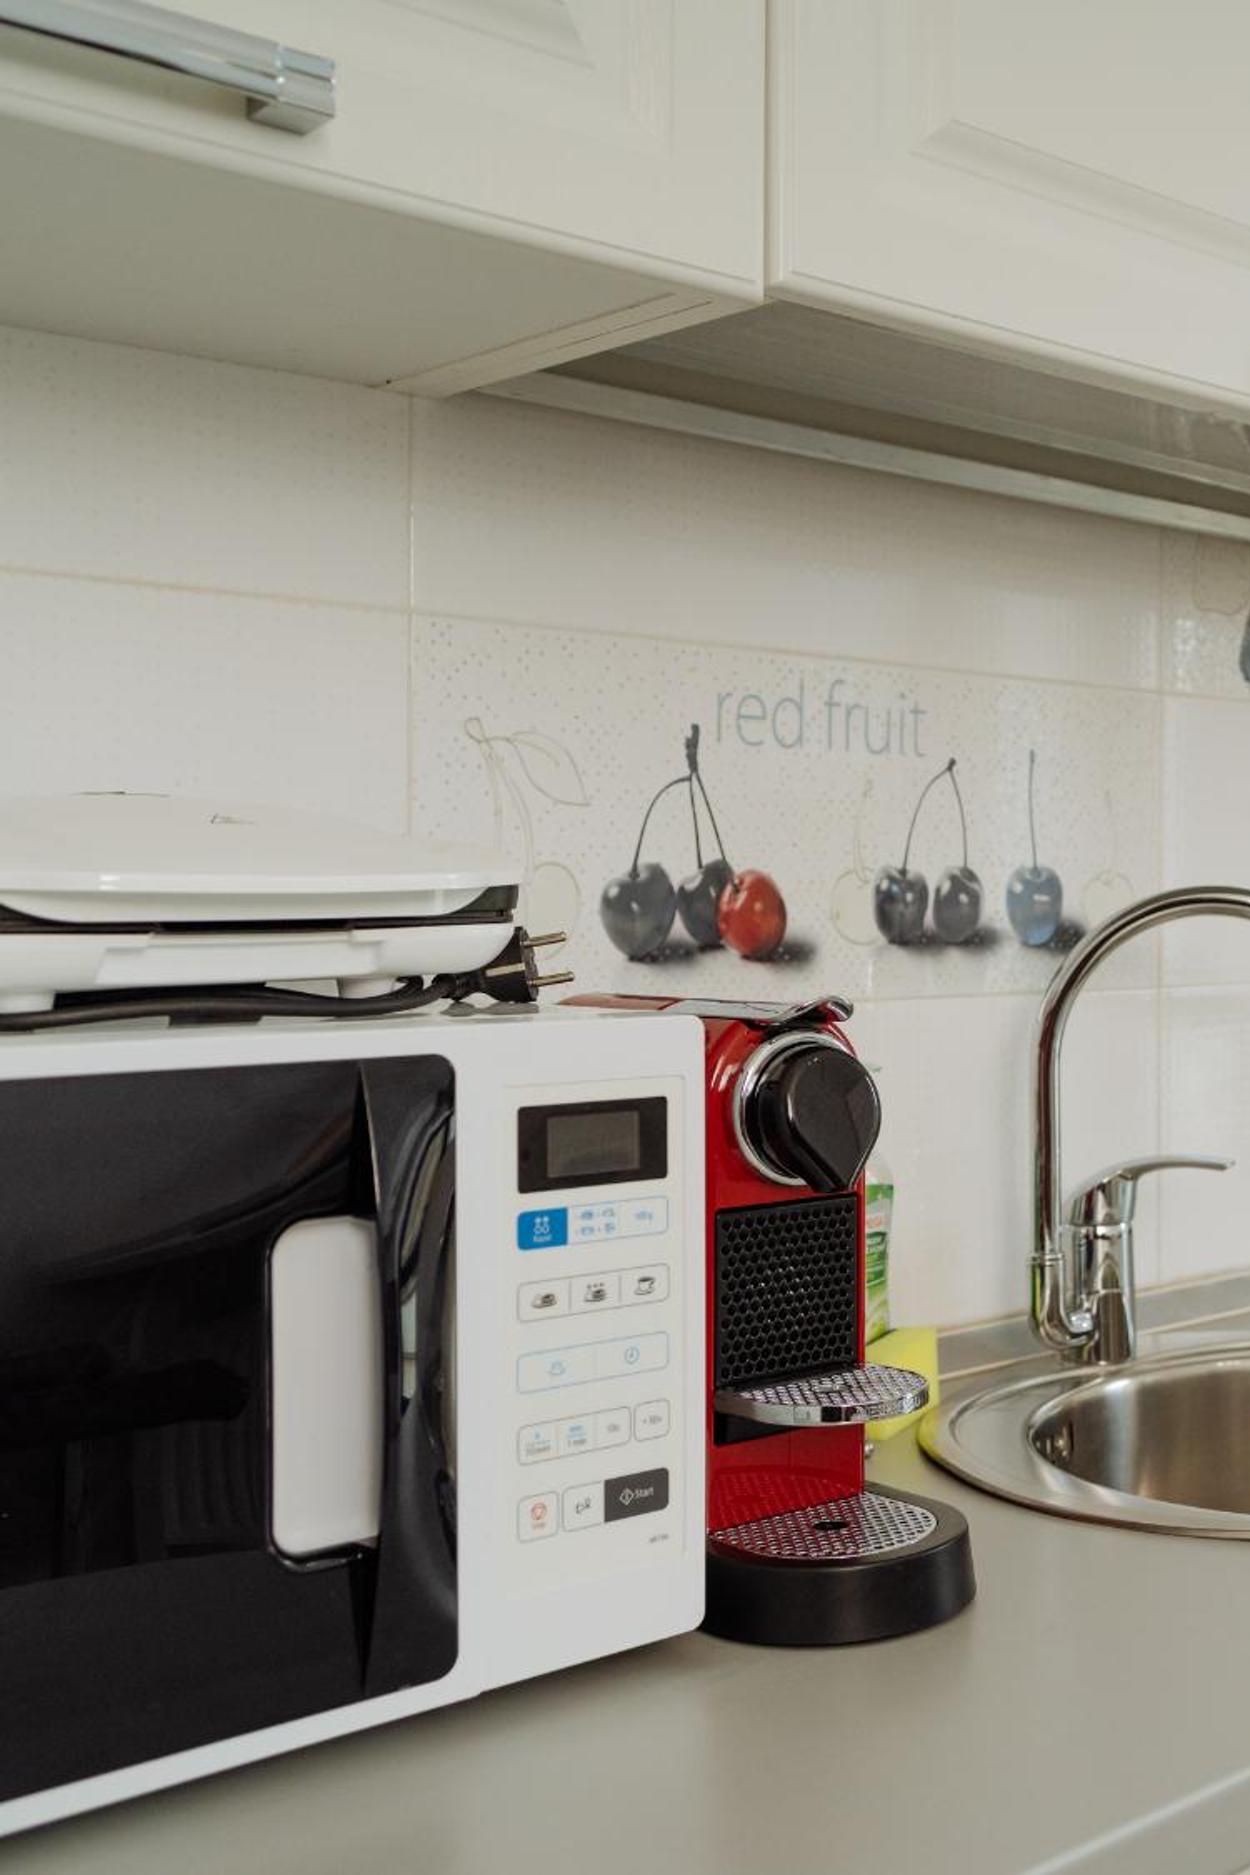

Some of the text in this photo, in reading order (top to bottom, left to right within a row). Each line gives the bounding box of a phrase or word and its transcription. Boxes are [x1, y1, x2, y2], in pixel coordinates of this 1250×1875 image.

[716, 677, 928, 758] red fruit
[634, 1487, 655, 1499] Start
